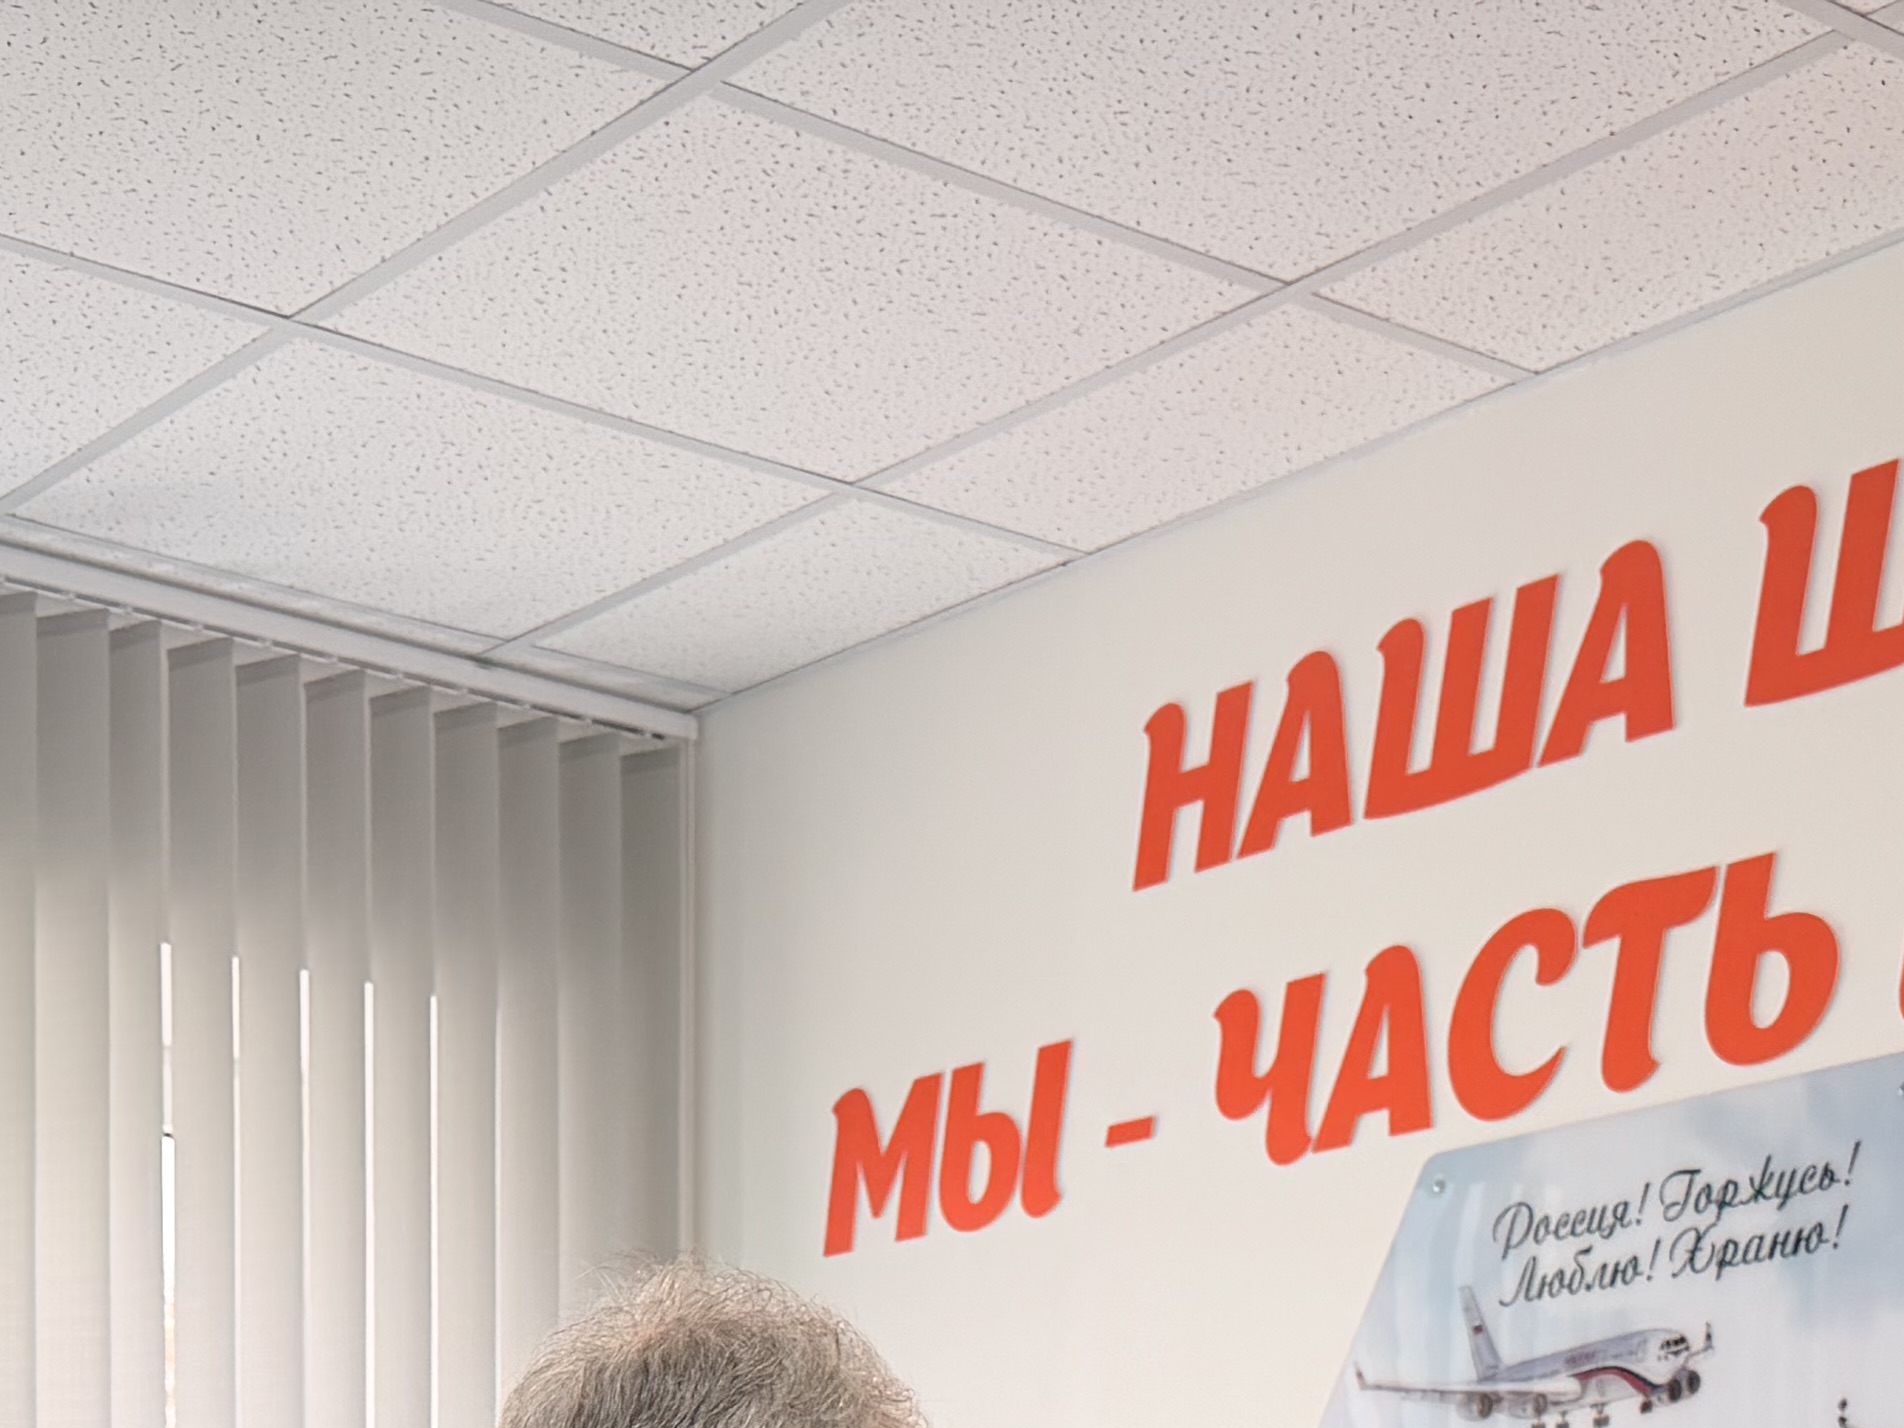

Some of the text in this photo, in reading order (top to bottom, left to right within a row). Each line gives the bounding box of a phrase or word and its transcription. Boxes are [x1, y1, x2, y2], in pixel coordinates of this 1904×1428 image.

[1134, 540, 1674, 890] НАША
[824, 1041, 1072, 1256] МЫ
[1215, 853, 1839, 1166] ЧАСТЬ
[1493, 1140, 1861, 1259] Россия! Горжусь!
[1499, 1204, 1849, 1307] Люблю! Храню!
